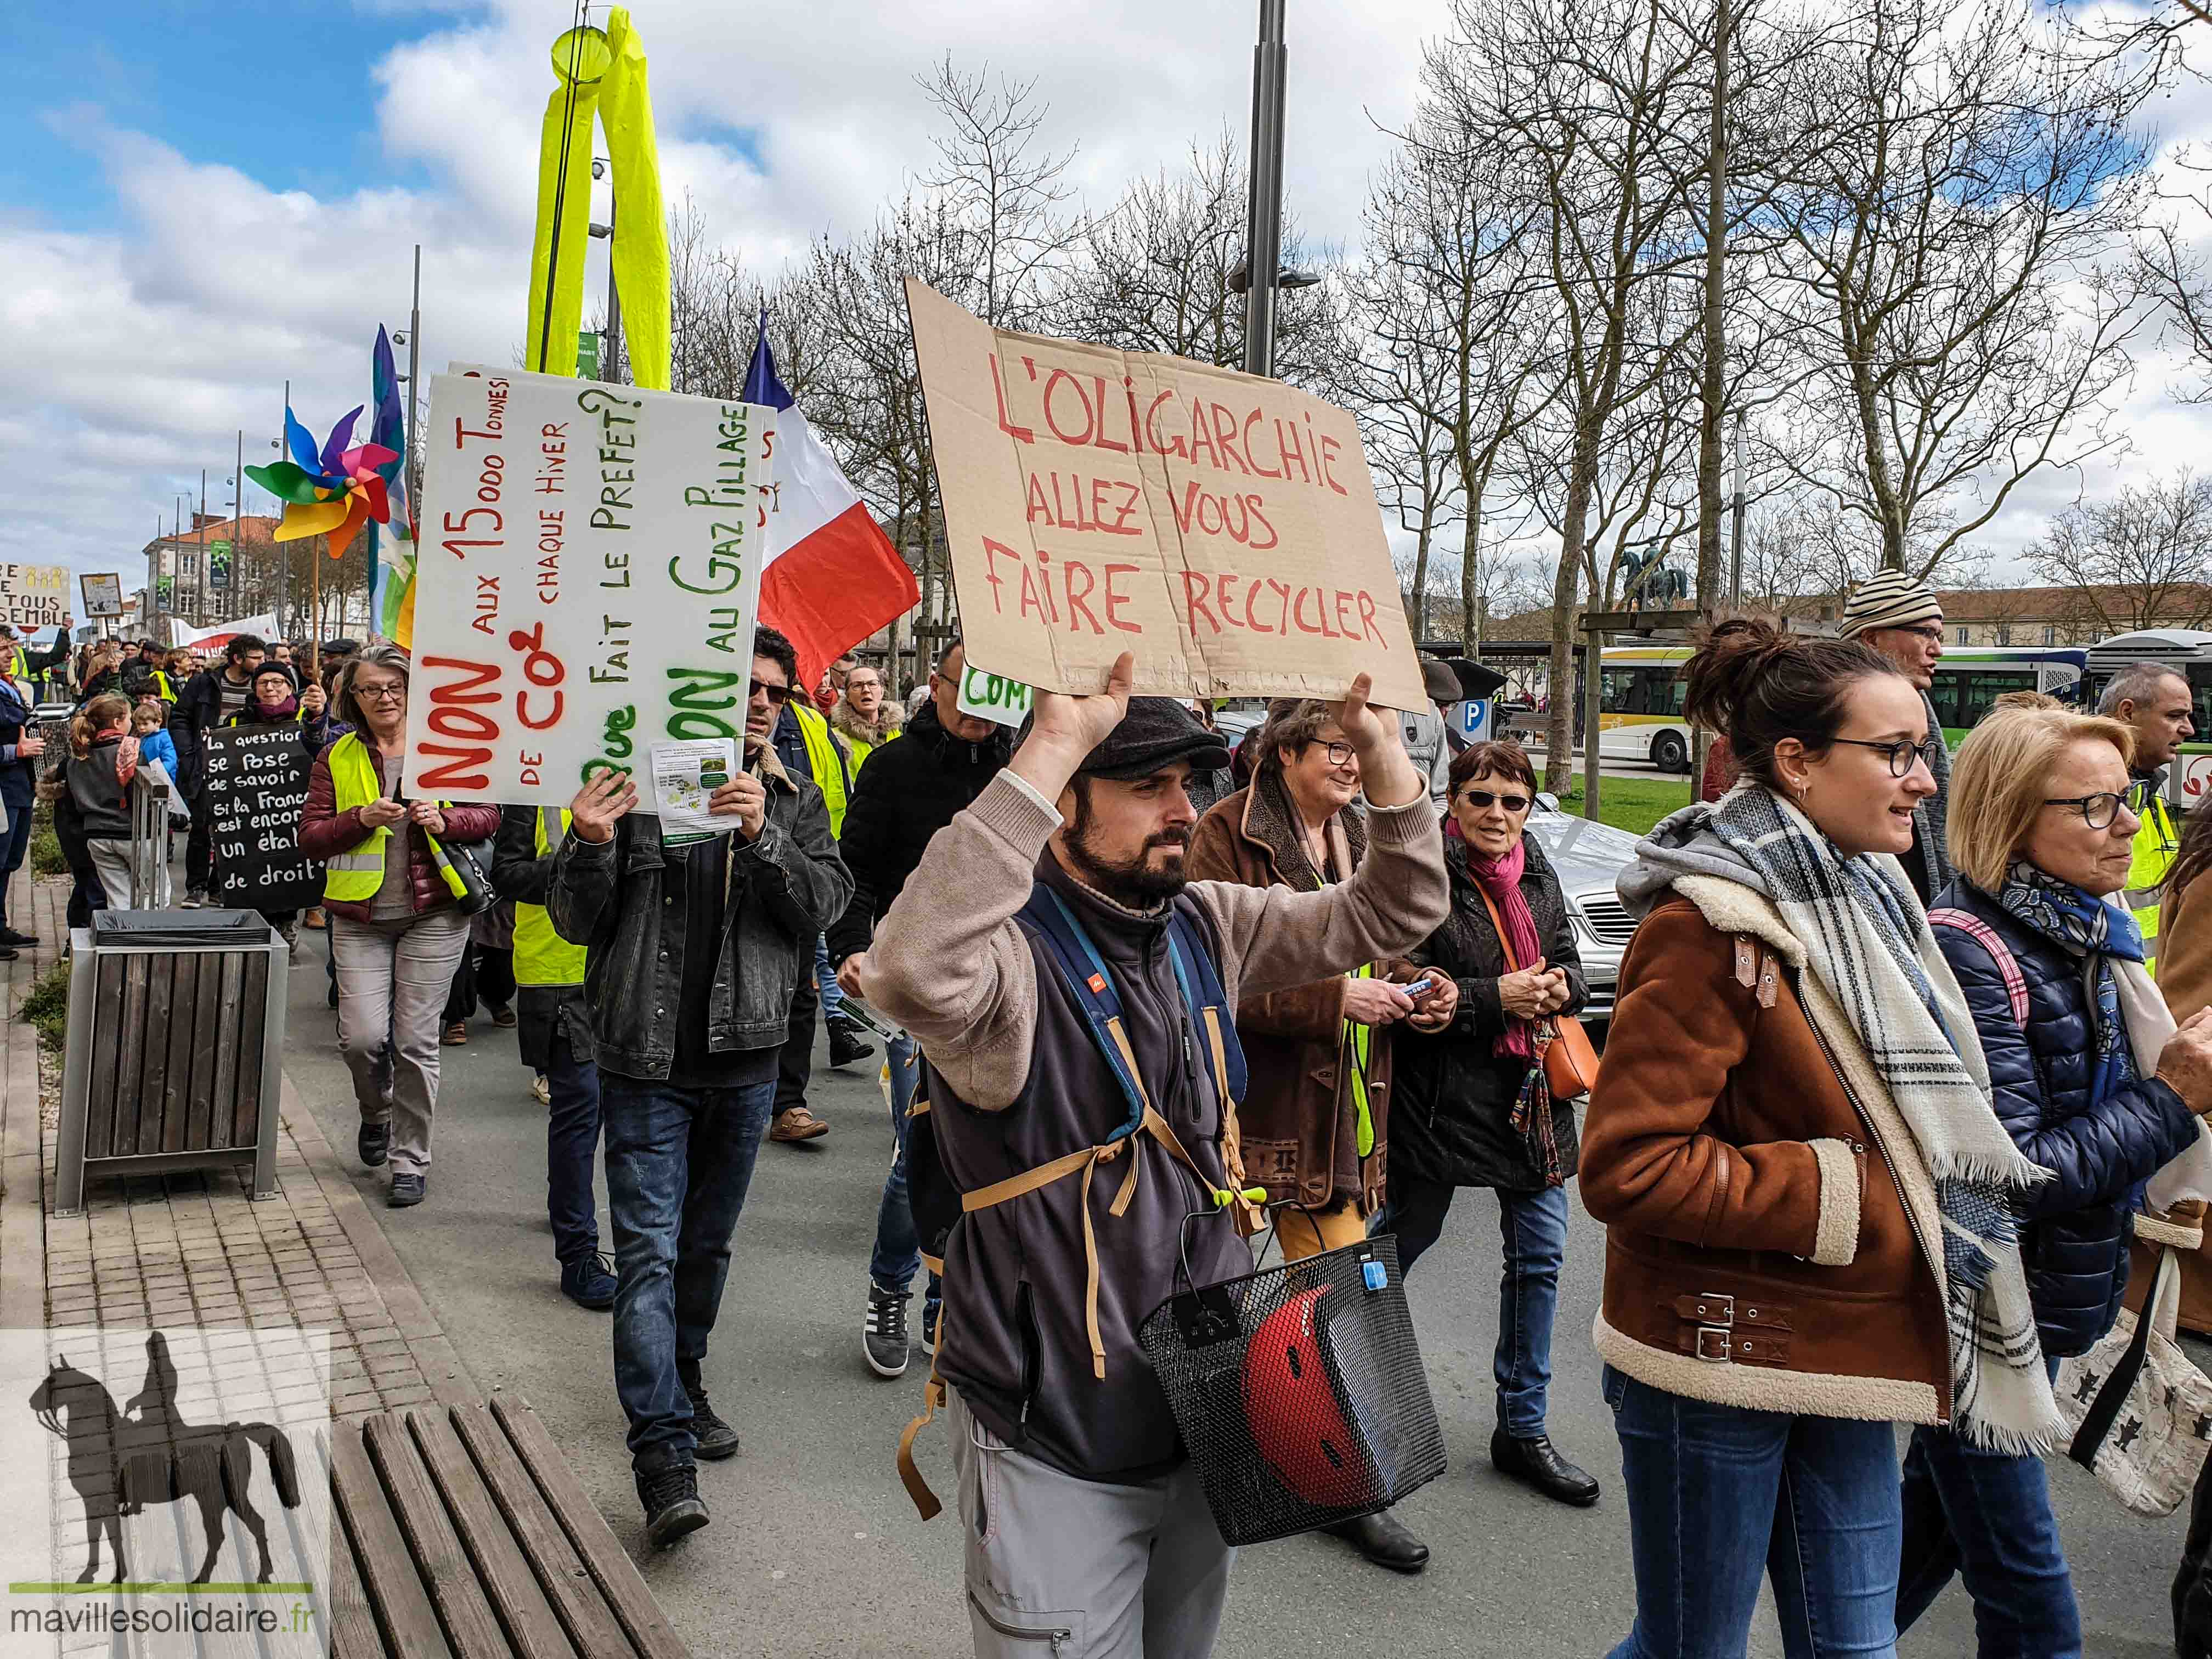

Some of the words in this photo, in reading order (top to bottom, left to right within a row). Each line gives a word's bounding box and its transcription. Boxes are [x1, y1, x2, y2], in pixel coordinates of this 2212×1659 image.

[1027, 472, 1142, 535] ALLEZ
[1167, 481, 1278, 549] VOUS
[600, 552, 630, 588] LE
[669, 521, 744, 594] GAZ
[4, 594, 60, 611] TOUS
[1178, 571, 1387, 650] RECYCLER
[520, 749, 542, 785] DE
[536, 510, 565, 604] CHAQUE
[705, 608, 738, 652] AU
[417, 656, 502, 789] NON
[472, 574, 500, 635] AUX
[965, 668, 1035, 711] COM
[1468, 703, 1480, 726] P
[208, 757, 228, 773] se
[208, 778, 227, 791] de
[234, 770, 300, 787] savoir
[217, 816, 242, 832] est
[250, 809, 302, 828] encor
[234, 796, 250, 814] la
[224, 873, 247, 889] de
